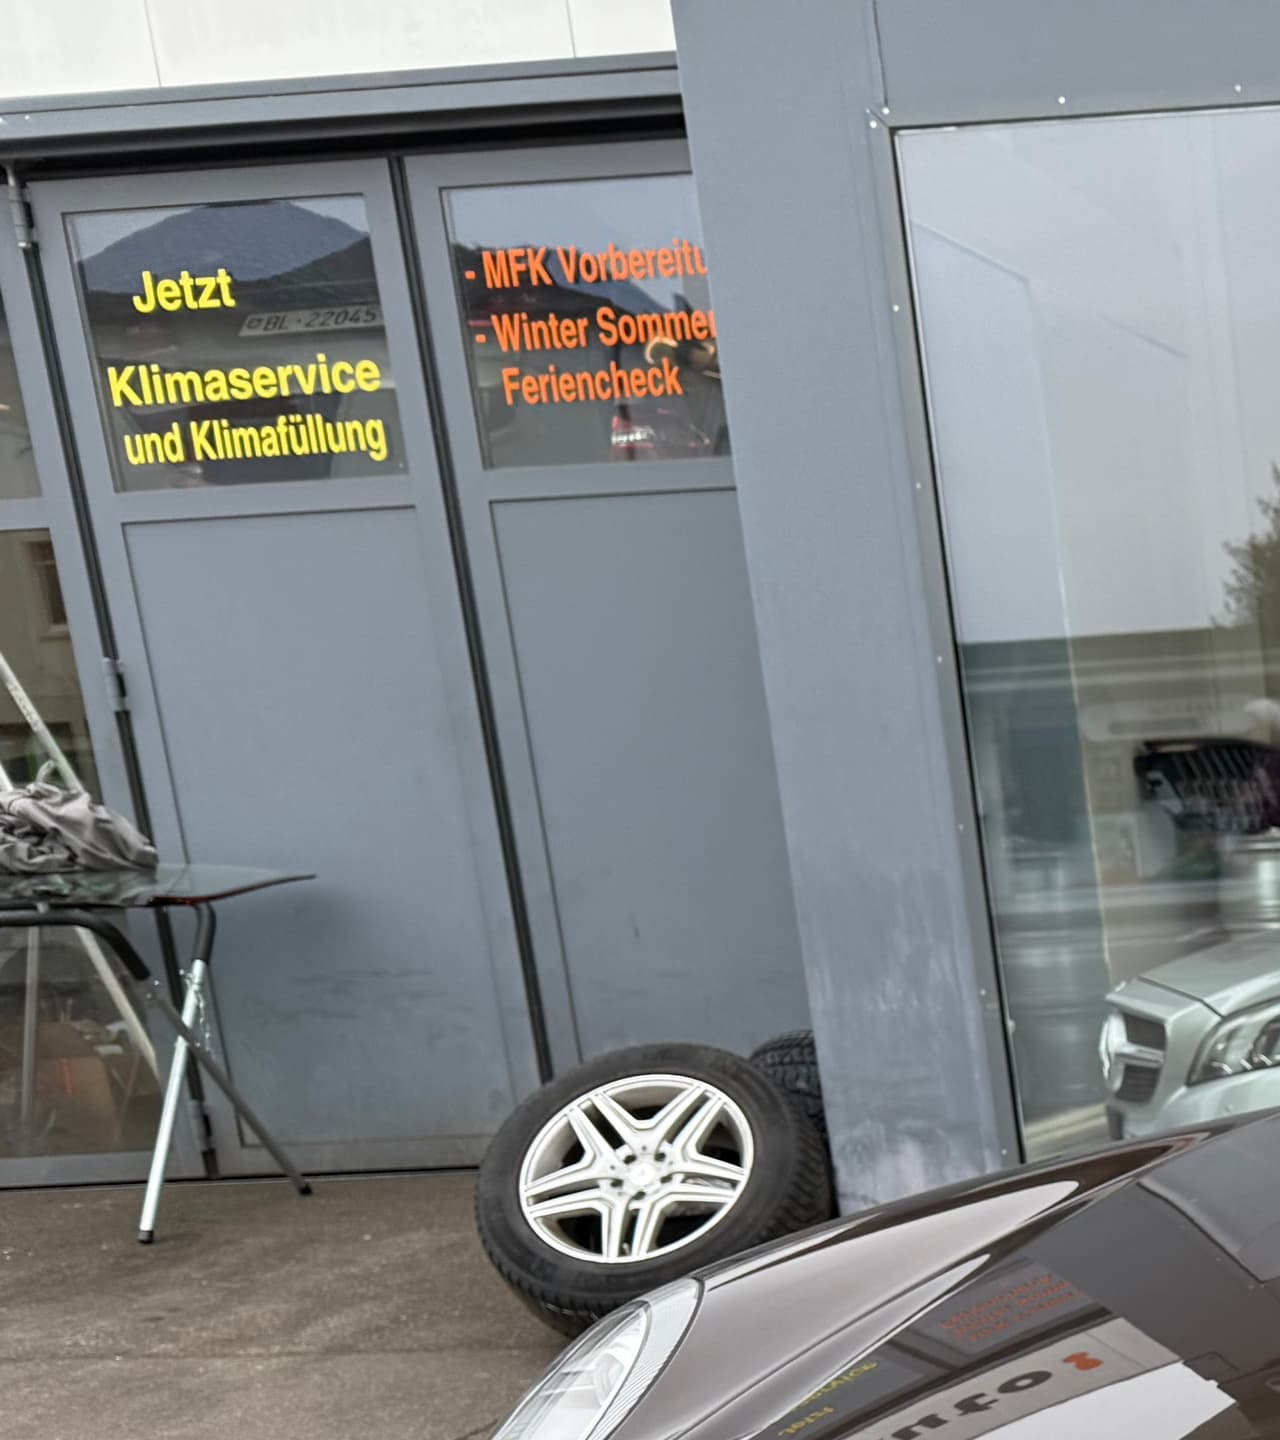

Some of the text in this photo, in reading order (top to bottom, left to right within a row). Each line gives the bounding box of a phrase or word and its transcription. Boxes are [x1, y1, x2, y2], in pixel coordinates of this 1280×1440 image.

[132, 268, 237, 314] Jetzt
[484, 247, 554, 290] MFK
[491, 308, 590, 353] Winter
[107, 352, 381, 408] Klimaservice
[503, 357, 684, 407] Feriencheck
[126, 415, 389, 466] und Klimafüllung
